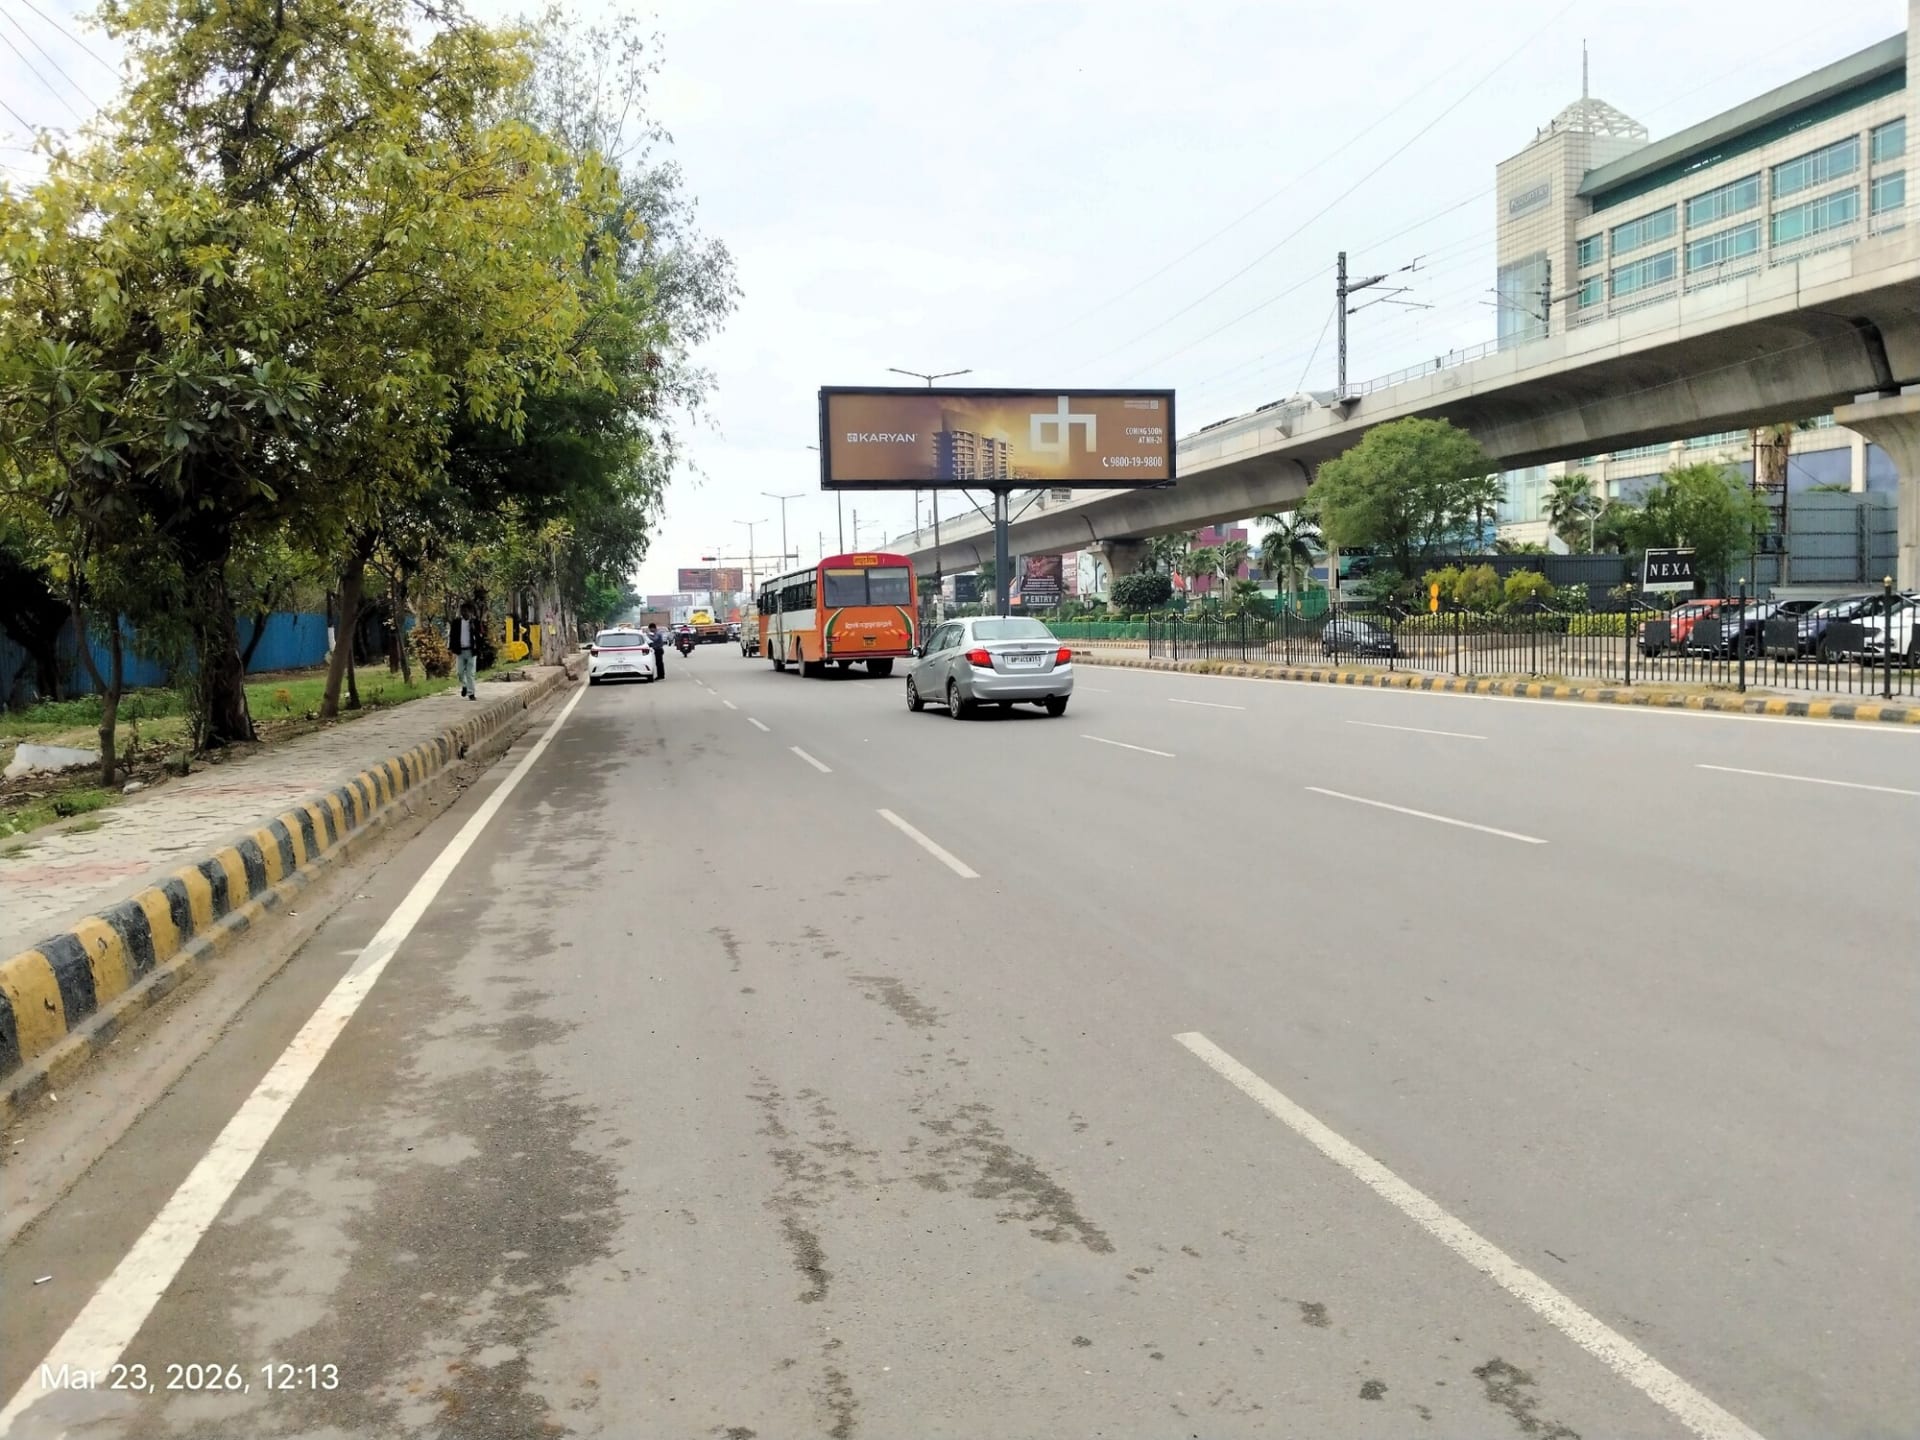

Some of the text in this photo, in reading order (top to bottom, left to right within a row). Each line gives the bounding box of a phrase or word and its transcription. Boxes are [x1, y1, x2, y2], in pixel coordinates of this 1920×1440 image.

[1126, 427, 1162, 435] COMING SOON
[859, 433, 915, 442] KARYAN
[1110, 456, 1162, 467] 9800-19-9800
[1650, 562, 1690, 576] NEXA
[1030, 595, 1052, 603] ENTRY
